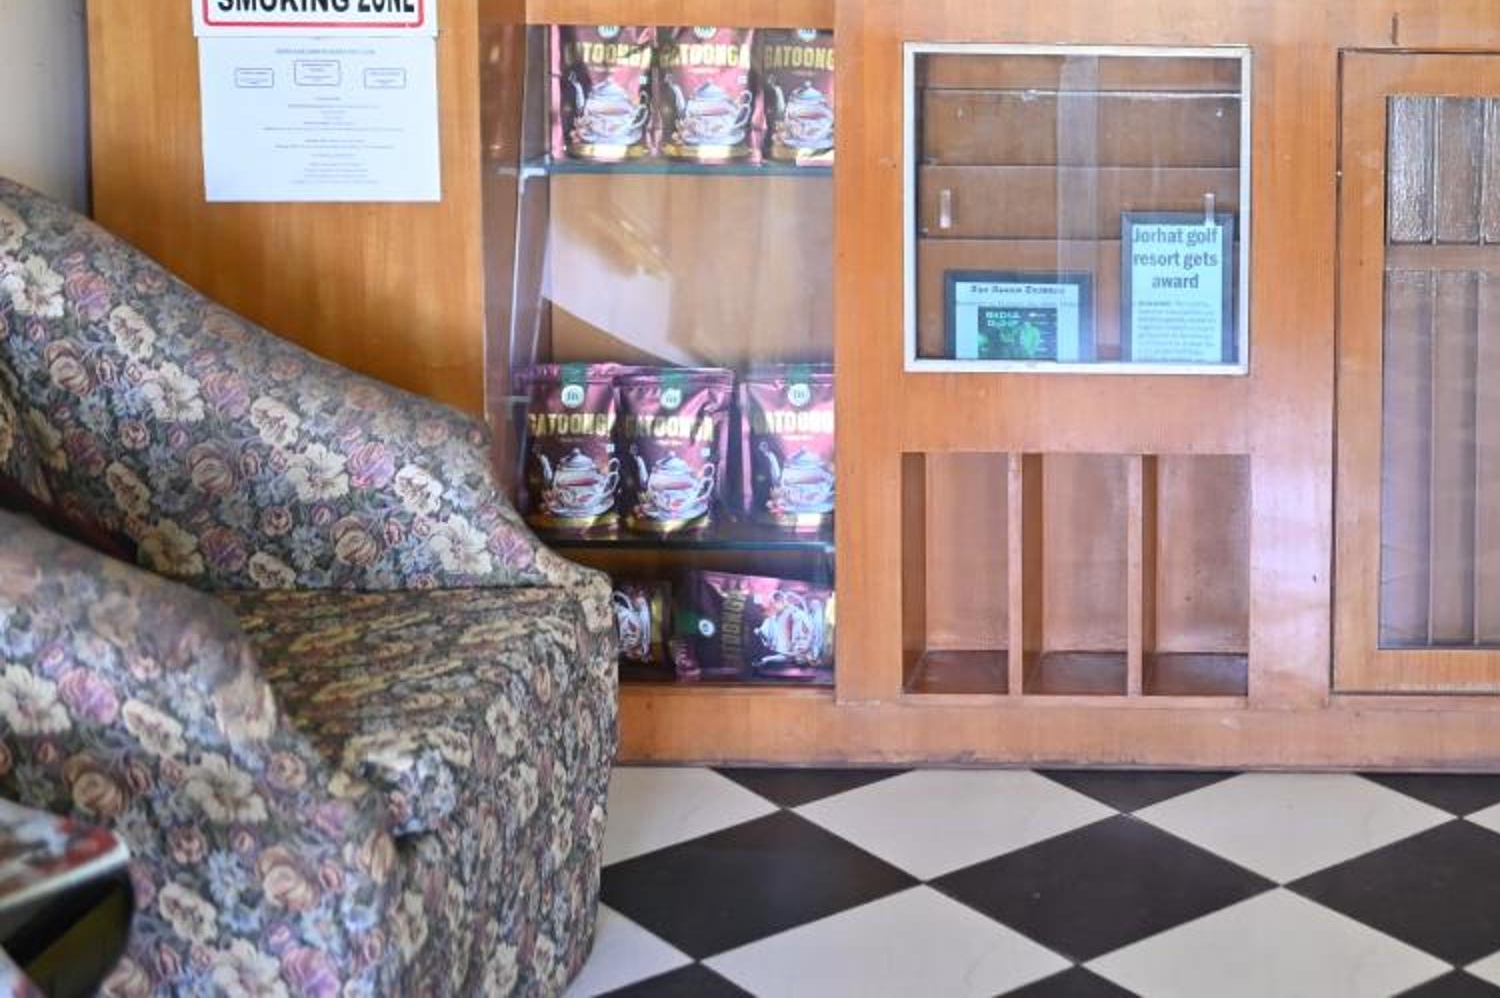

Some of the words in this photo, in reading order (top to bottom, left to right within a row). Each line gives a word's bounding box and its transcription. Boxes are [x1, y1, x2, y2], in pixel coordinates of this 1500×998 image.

[1133, 227, 1183, 243] Jorhat
[1186, 227, 1218, 246] golf
[1133, 252, 1180, 267] resort
[1183, 251, 1218, 270] gets
[1151, 274, 1199, 289] award
